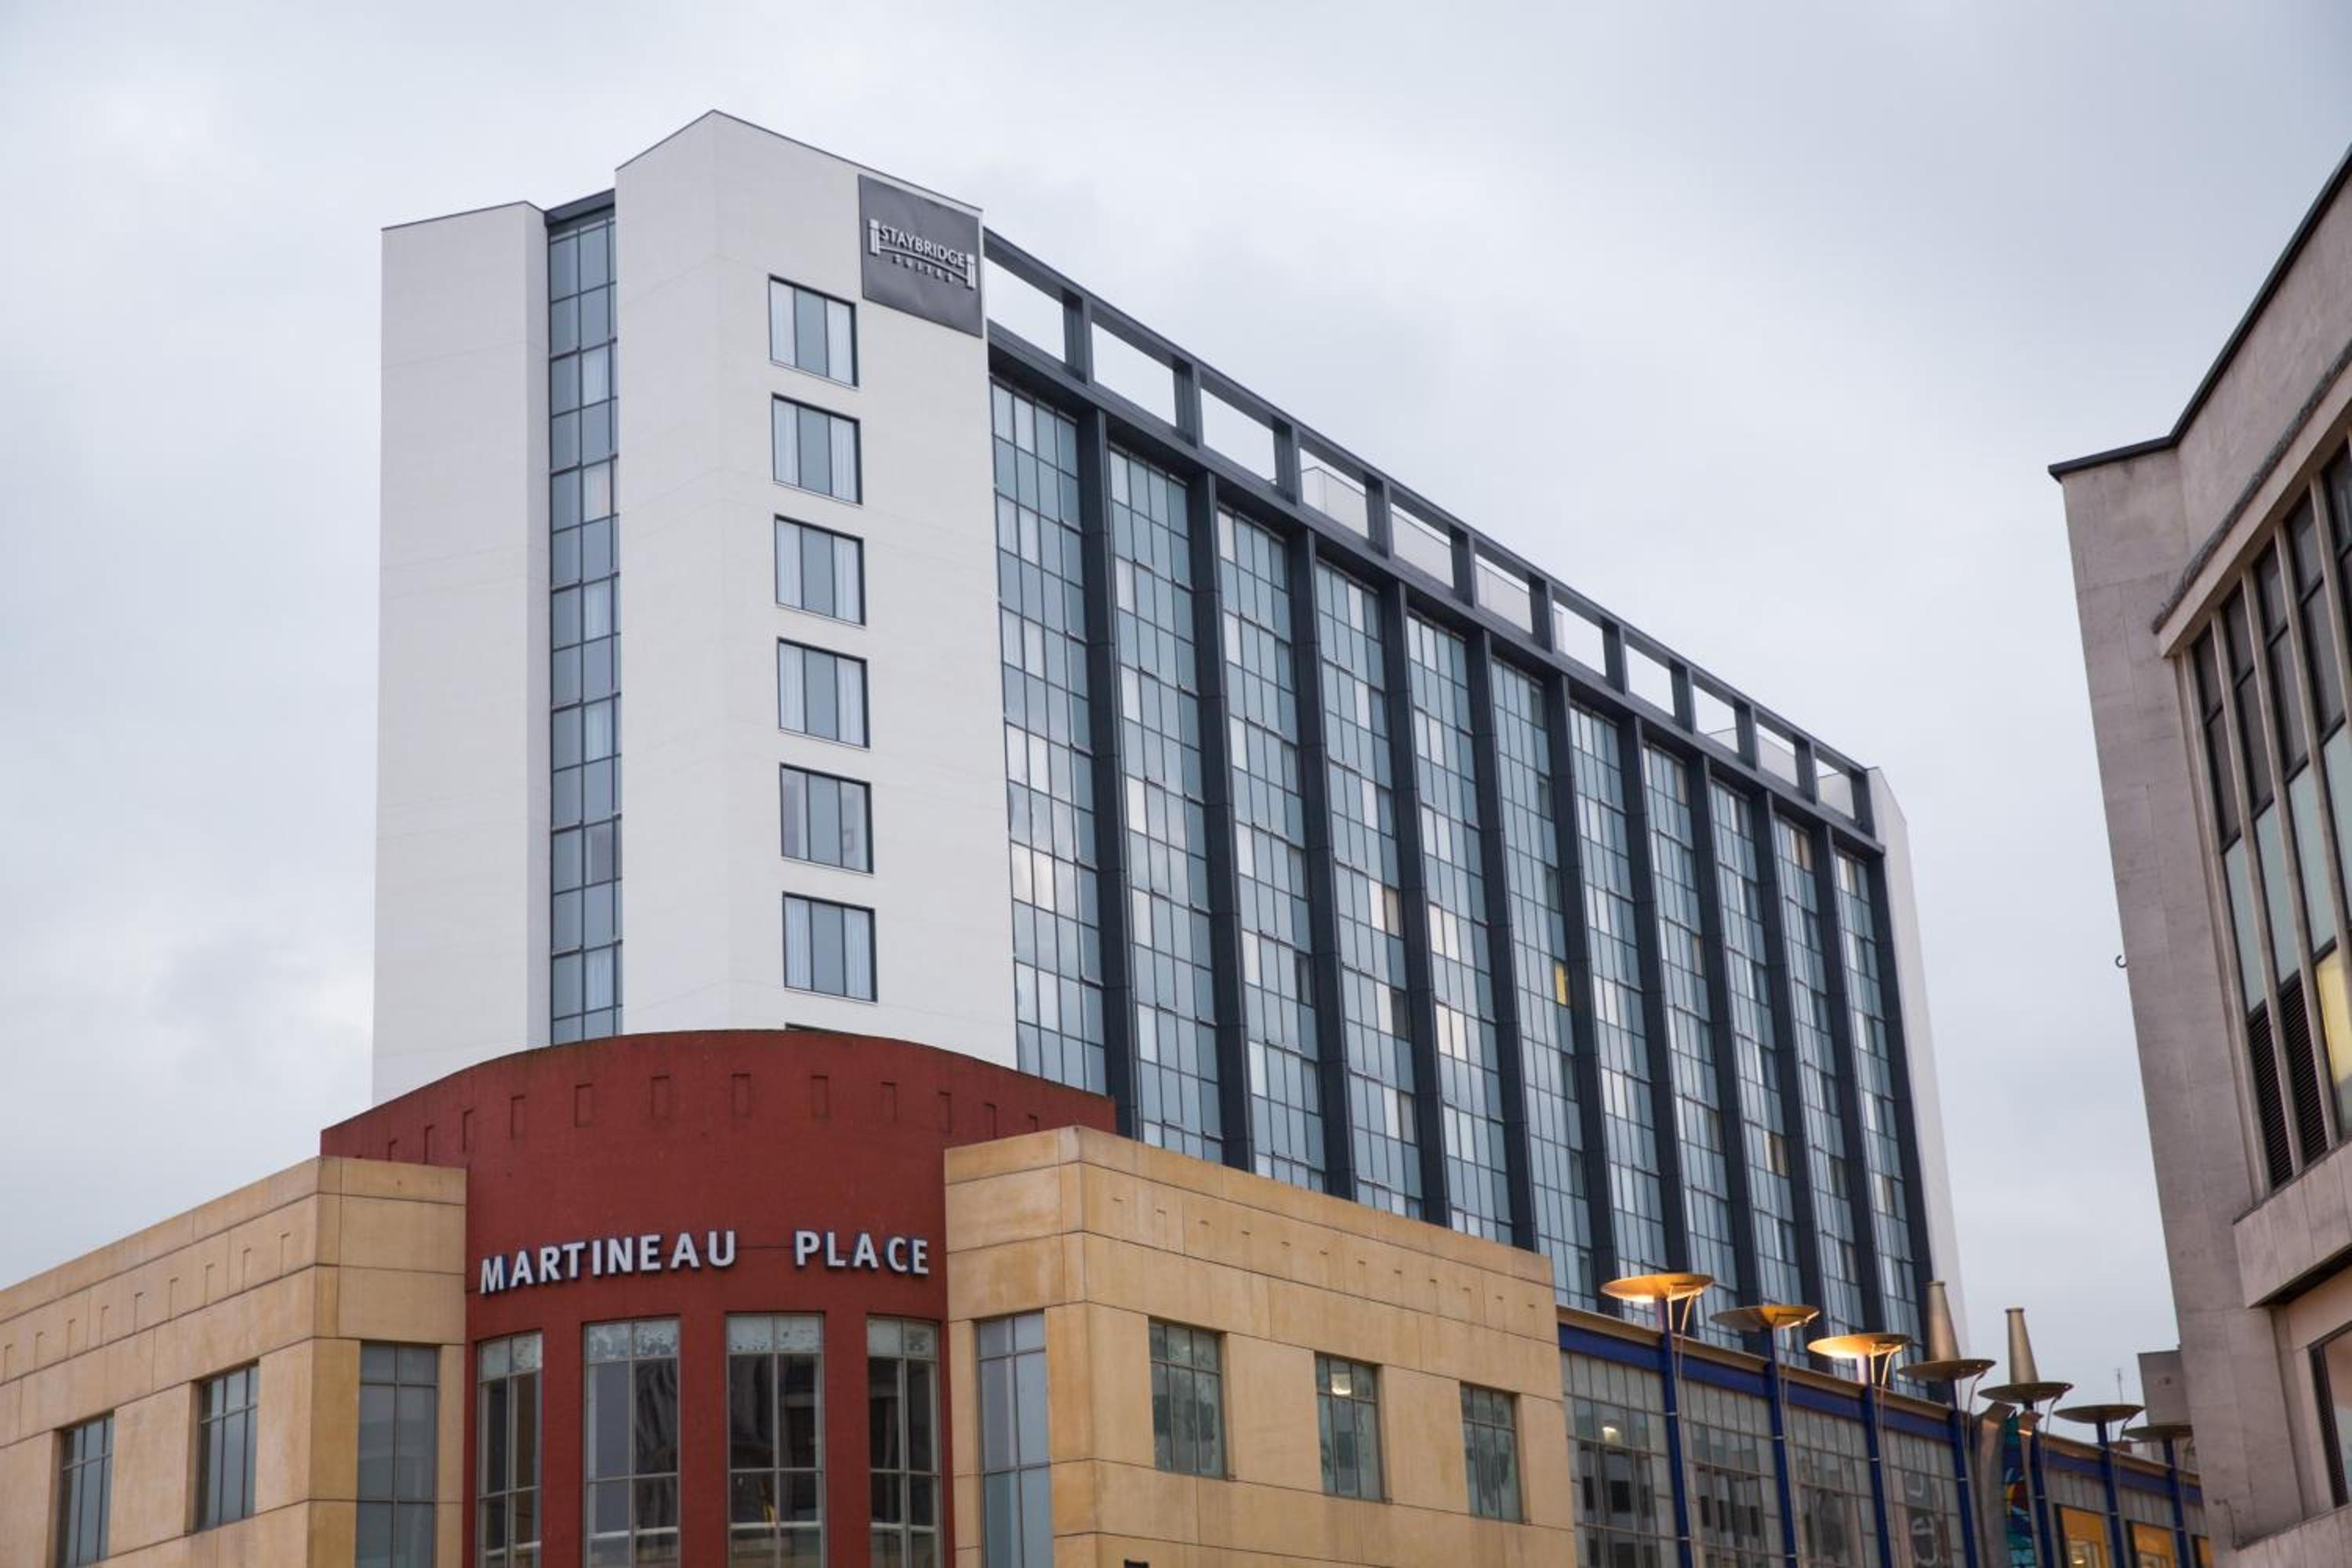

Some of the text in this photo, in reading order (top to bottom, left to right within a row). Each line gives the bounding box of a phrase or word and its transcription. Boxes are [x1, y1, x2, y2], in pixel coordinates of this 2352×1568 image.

[879, 224, 965, 269] STAYBRIDGE
[479, 1229, 930, 1294] MARTINEAU PLACE
